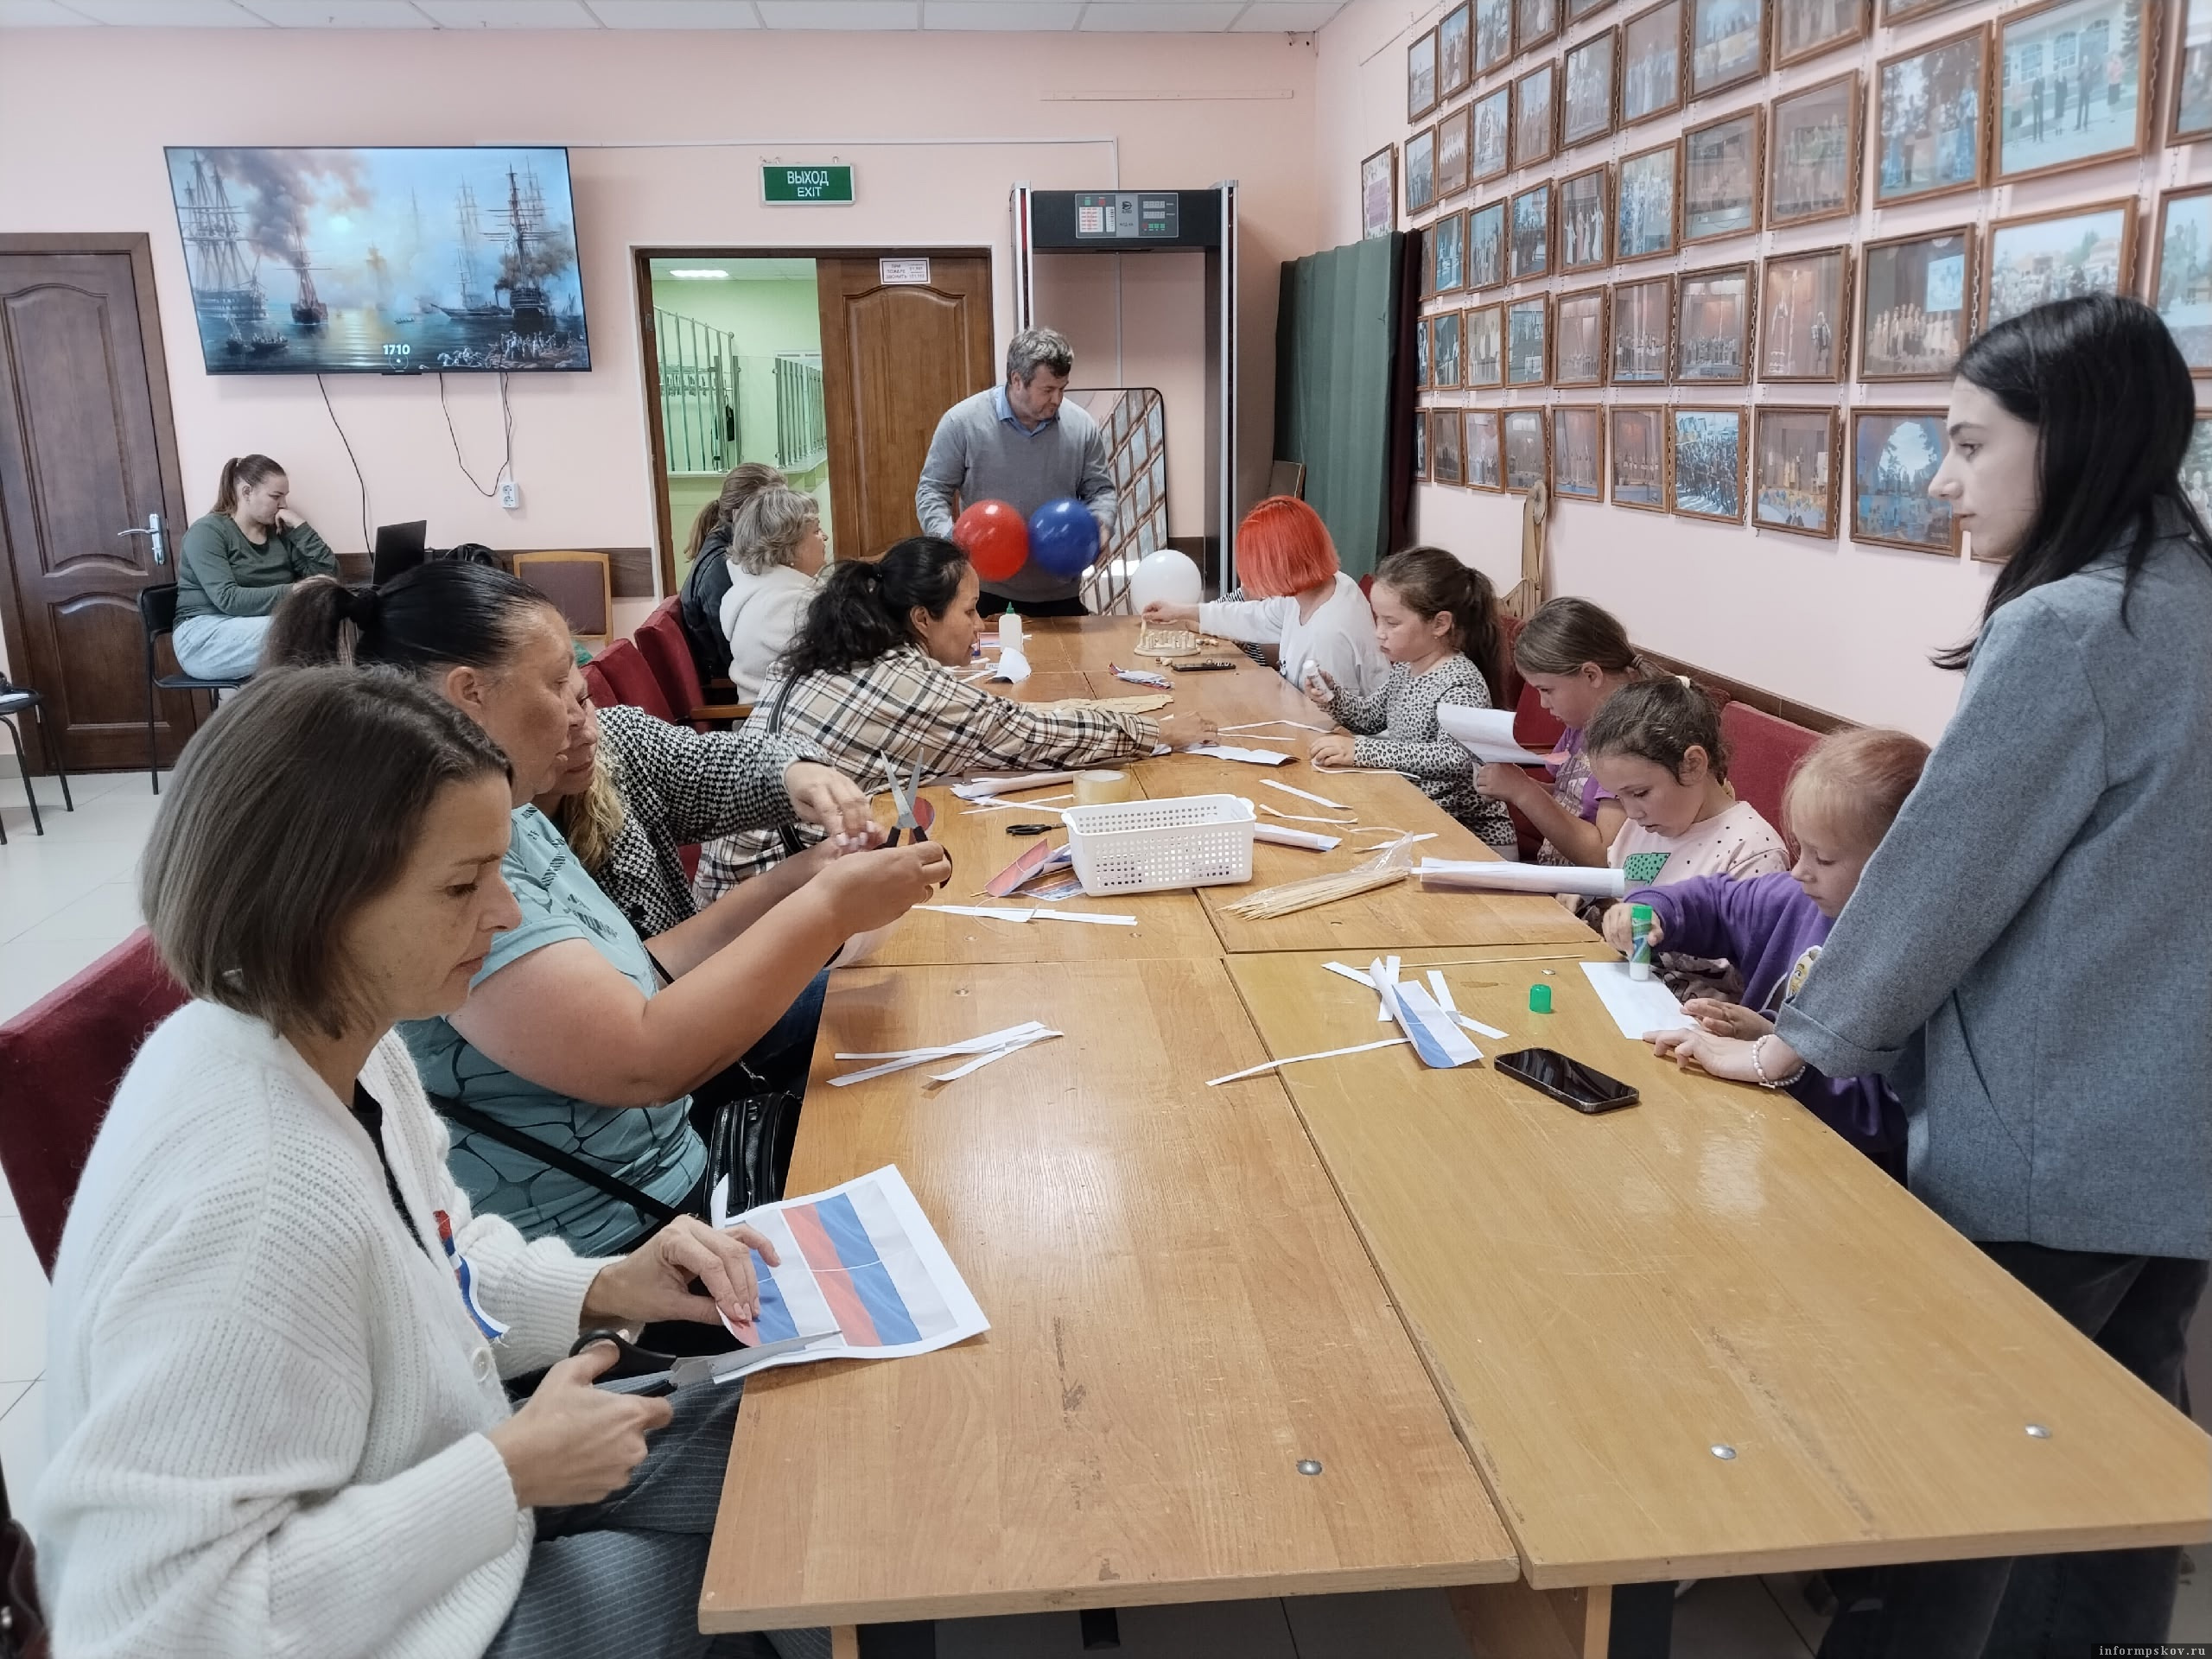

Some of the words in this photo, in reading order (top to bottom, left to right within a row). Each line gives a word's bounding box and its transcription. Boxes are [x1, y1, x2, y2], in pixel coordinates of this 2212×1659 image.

[787, 170, 830, 187] ВЫХОД
[797, 187, 823, 197] EXIT
[383, 343, 410, 355] 1710
